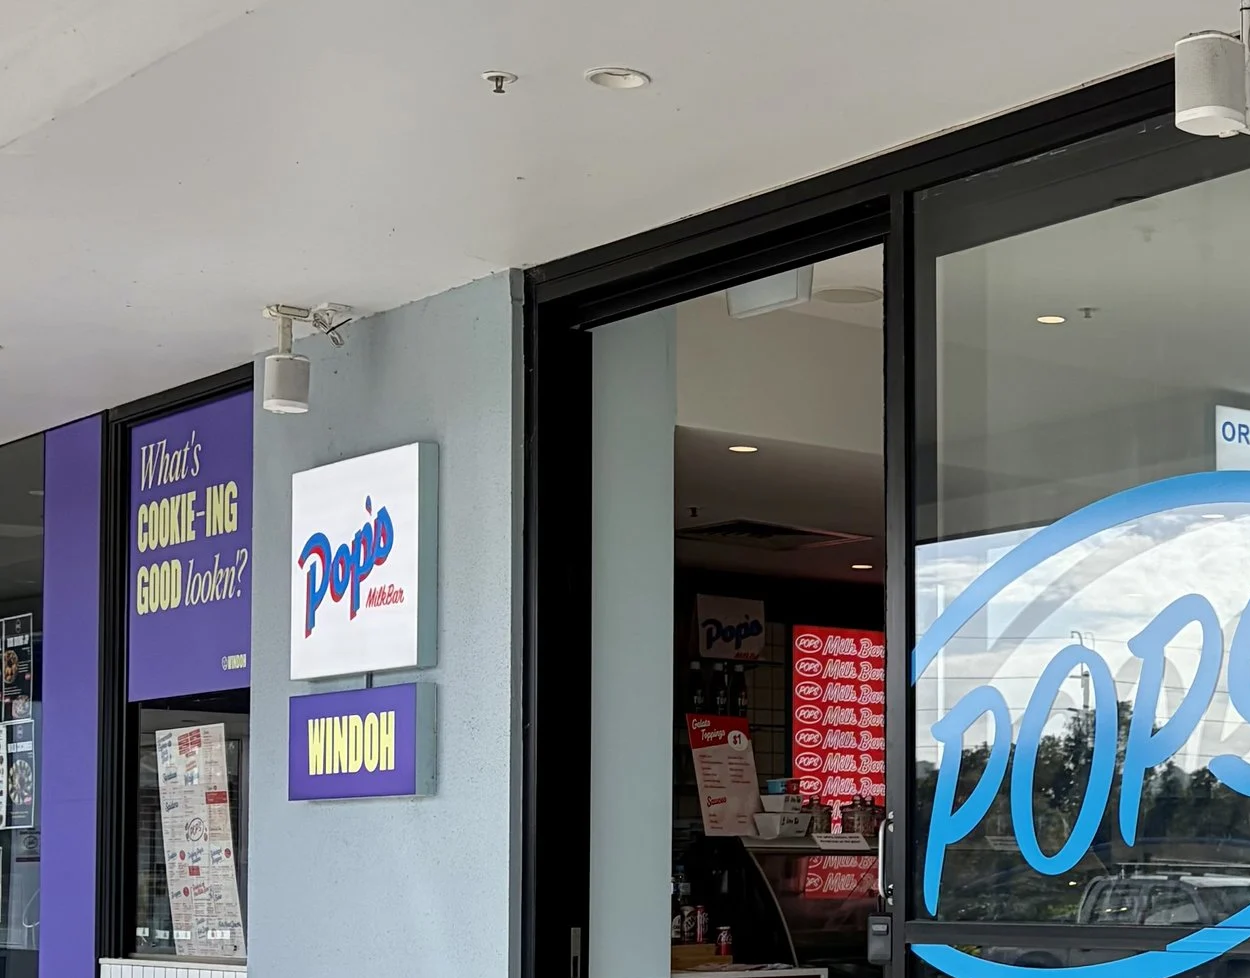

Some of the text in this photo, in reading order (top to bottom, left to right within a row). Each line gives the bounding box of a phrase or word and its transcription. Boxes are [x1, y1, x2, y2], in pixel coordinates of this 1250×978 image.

[140, 430, 201, 491] What's
[137, 480, 238, 553] COOKIE-ING
[298, 495, 394, 639] Pop's
[137, 548, 248, 616] GOOD lookn'?
[822, 635, 857, 656] Milk
[822, 658, 857, 680] Milk
[822, 682, 857, 703] Milk
[822, 706, 857, 726] Milk
[307, 711, 396, 776] WINDOH
[701, 728, 726, 741] Toppings
[732, 733, 742, 745] $1
[822, 729, 857, 750] Milk
[822, 752, 857, 773] Milk
[822, 776, 857, 797] Milk
